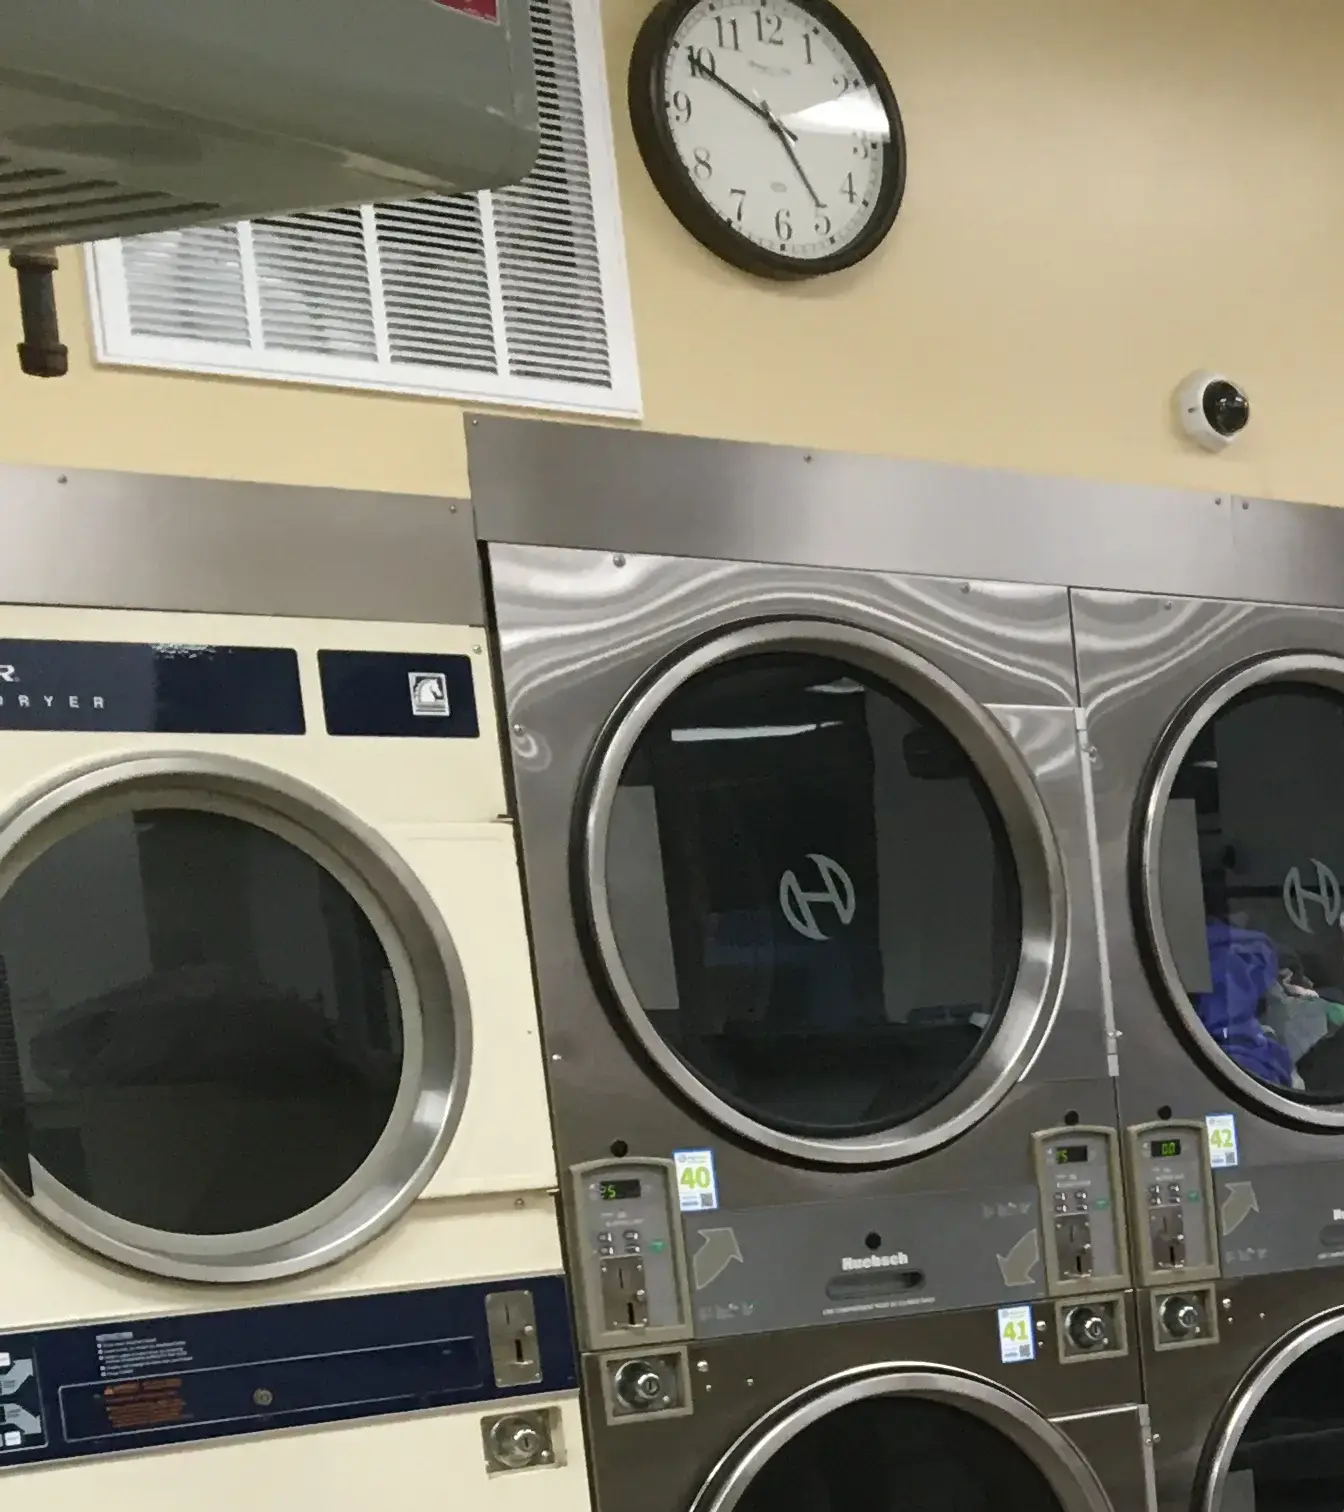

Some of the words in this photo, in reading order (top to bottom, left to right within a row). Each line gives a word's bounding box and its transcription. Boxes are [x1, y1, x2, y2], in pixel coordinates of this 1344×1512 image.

[714, 15, 741, 51] 11
[753, 10, 784, 46] 12
[686, 45, 717, 82] 10
[803, 33, 814, 65] 1
[673, 90, 692, 124] 9
[851, 130, 869, 160] 3
[692, 147, 713, 181] 8
[839, 171, 858, 204] 4
[729, 187, 747, 222] 7
[813, 203, 832, 236] 5
[774, 207, 793, 242] 6
[1210, 1129, 1234, 1149] 42
[680, 1166, 711, 1189] 40
[841, 1251, 909, 1271] Huebsch
[1003, 1319, 1030, 1341] 41
